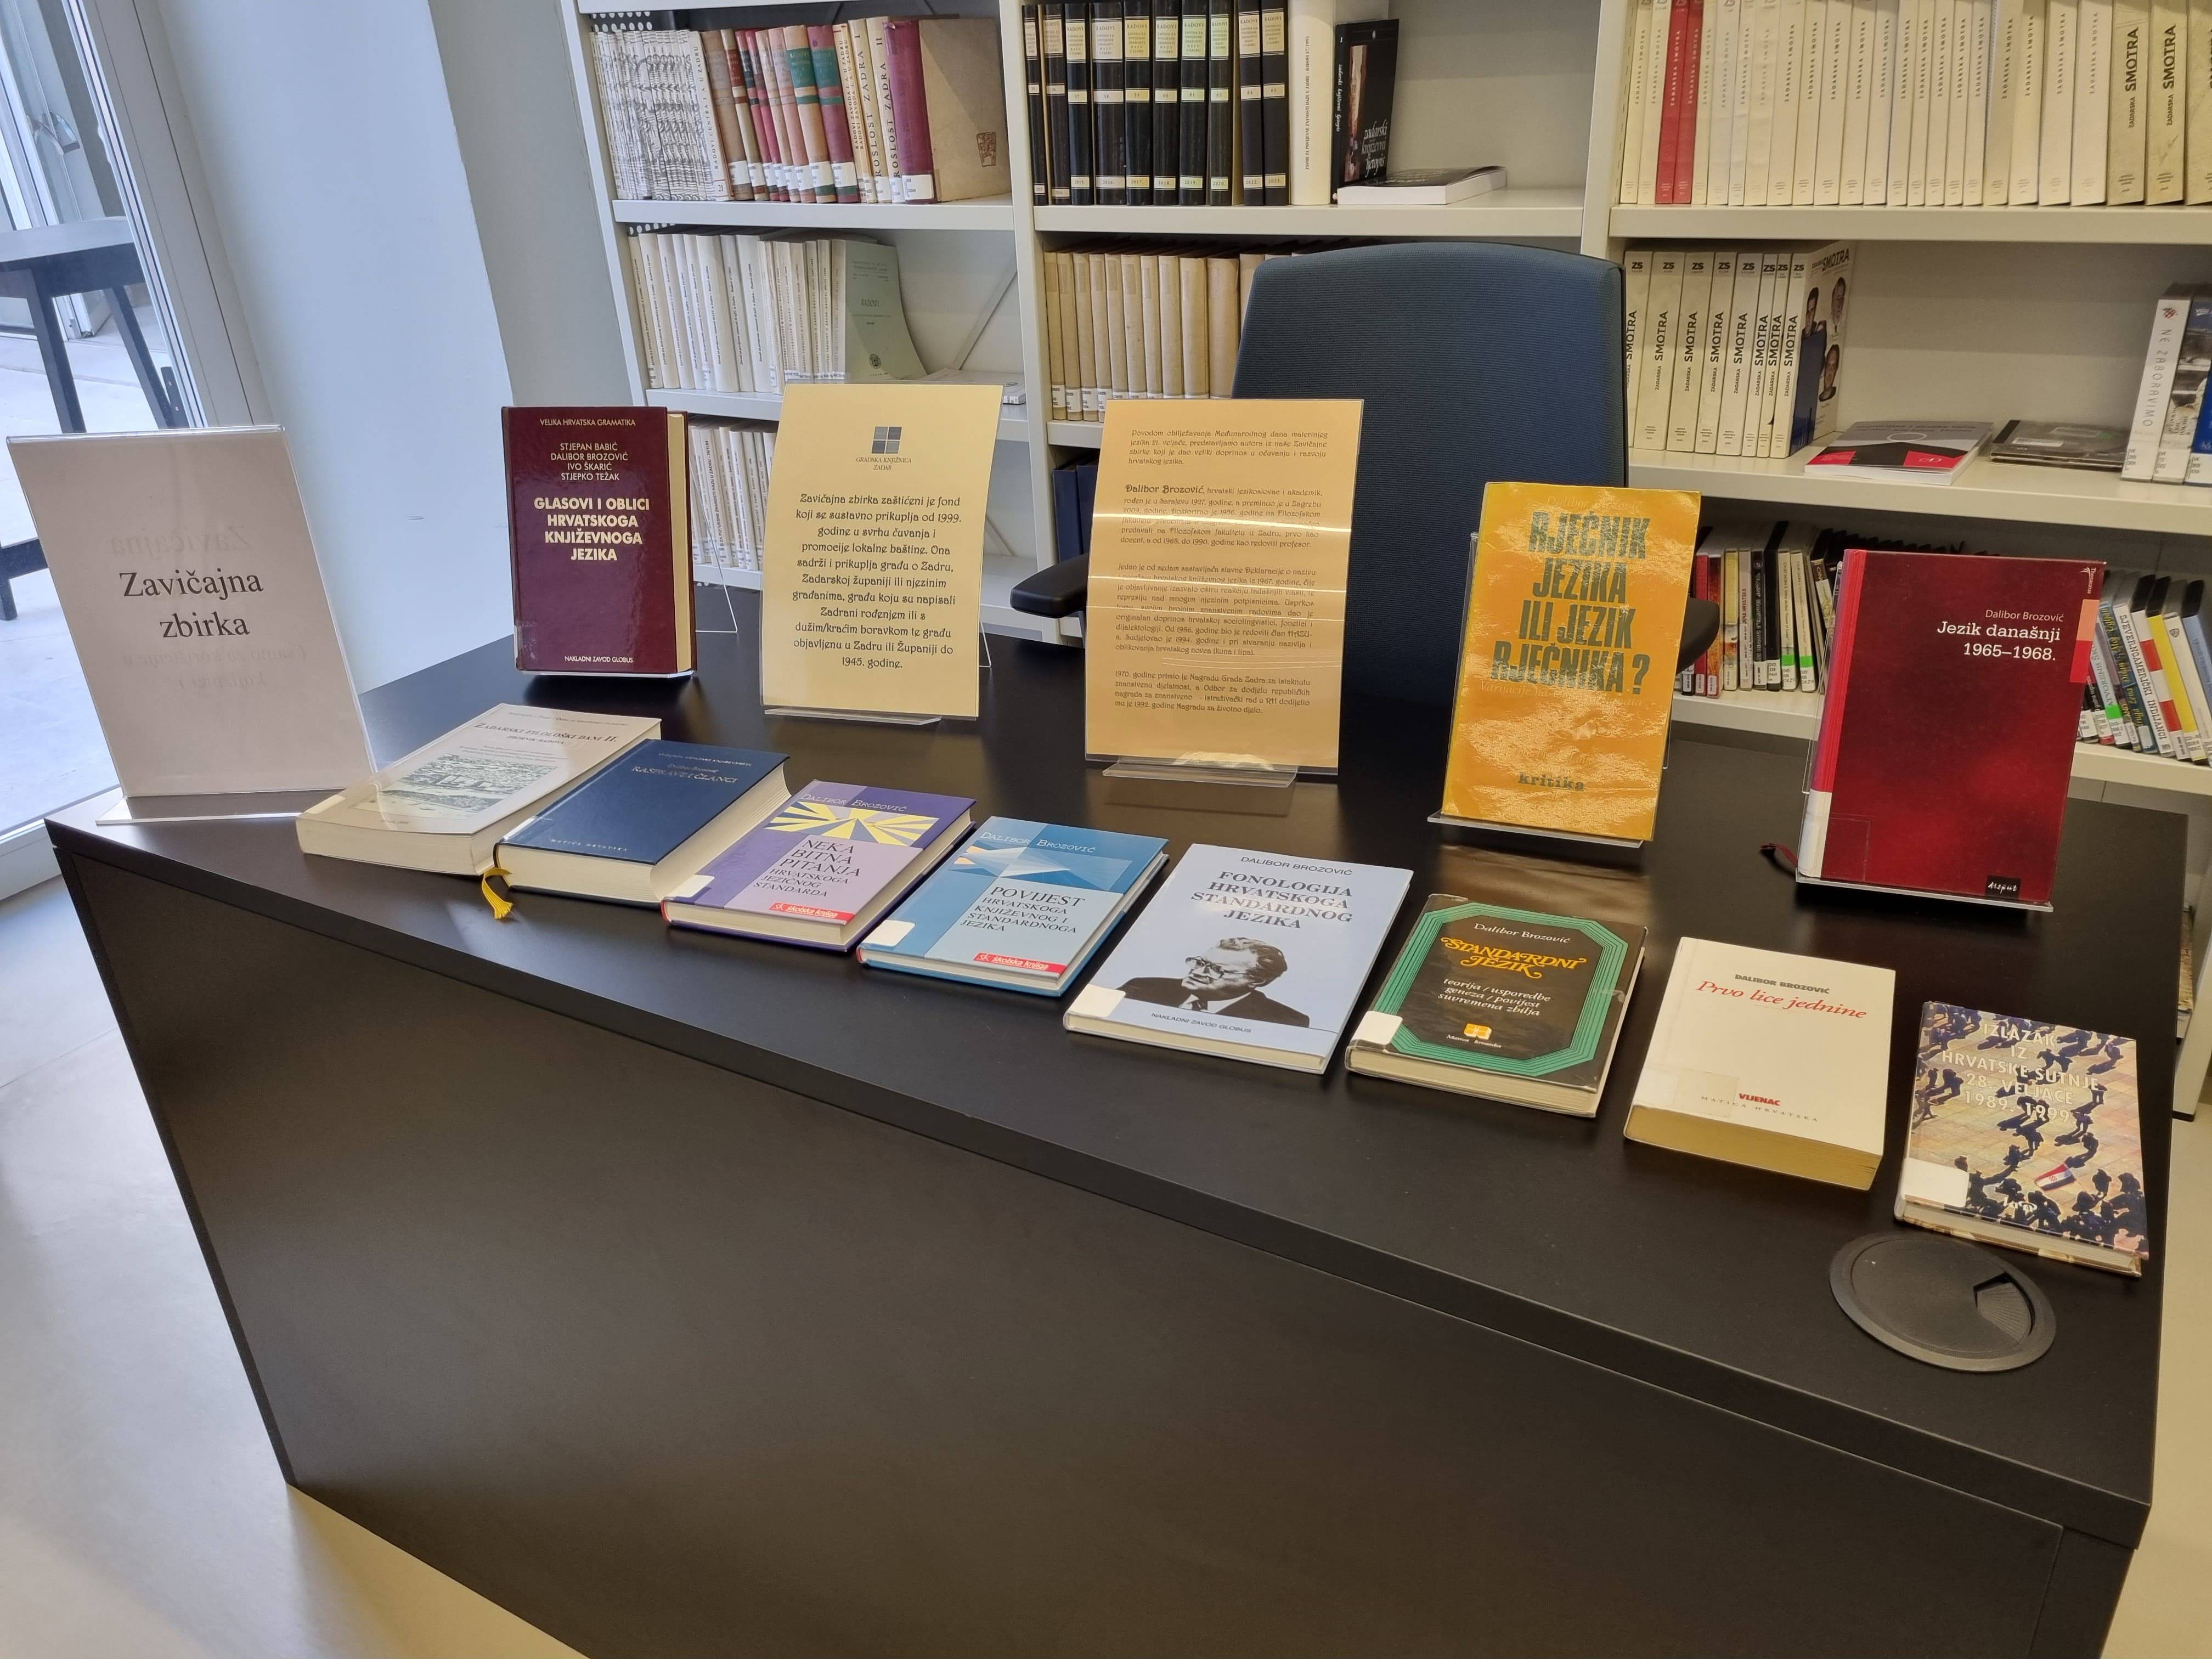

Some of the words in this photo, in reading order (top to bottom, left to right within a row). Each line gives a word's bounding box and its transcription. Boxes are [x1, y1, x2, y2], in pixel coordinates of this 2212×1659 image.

[2125, 27, 2140, 92] SMOTRA
[858, 50, 870, 101] ZADRA
[1364, 119, 1388, 139] zadarski
[1655, 311, 1668, 361] SMOTRA
[1684, 312, 1697, 362] SMOTRA
[2159, 329, 2172, 343] NE
[2142, 350, 2167, 427] ZABORAVIMO
[595, 441, 618, 451] BABIĆ
[584, 461, 612, 471] ŠKARIĆ
[587, 452, 628, 461] BROZOVIĆ
[595, 471, 619, 481] TEŽAK
[1125, 484, 1159, 493] Dalibor
[1162, 485, 1205, 494] Brozović,
[1237, 488, 1279, 496] jezikoslovac
[534, 497, 593, 510] GLASOVI
[597, 498, 602, 510] I
[606, 499, 650, 510] OBLICI
[800, 493, 845, 505] Zavičajna
[849, 494, 878, 504] zbirka
[881, 495, 924, 506] zaštićeni
[926, 496, 935, 507] je
[937, 495, 960, 507] fond
[548, 515, 638, 527] HRVATSKOGA
[796, 510, 813, 521] koji
[830, 511, 873, 521] sustavno
[876, 511, 919, 522] prikuplja
[922, 512, 935, 522] od
[938, 513, 961, 523] 1999.
[545, 528, 642, 544] KNJIŽEVNOGA
[817, 527, 850, 537] godine
[862, 527, 890, 537] svrhu
[892, 527, 930, 539] čuvanja
[933, 528, 936, 538] i
[1529, 511, 1650, 560] RJEČNIK
[571, 549, 617, 561] JEZIKA
[119, 568, 263, 600] Zavičajna
[1533, 558, 1627, 602] JEZIKA
[160, 611, 250, 639] zbirka
[1519, 601, 1549, 640] ILI
[1556, 604, 1635, 649] JEZIK
[1985, 610, 2020, 620] Dalibor
[2022, 612, 2064, 622] Brozović
[1937, 622, 1980, 636] Jezik
[1986, 625, 2061, 641] današnji
[793, 638, 843, 652] objavljenu
[854, 640, 882, 652] Zadru
[885, 642, 894, 652] ili
[897, 640, 938, 656] Županiji
[941, 645, 953, 654] do
[842, 657, 865, 667] 1945.
[868, 657, 903, 669] godine.
[1490, 641, 1624, 693] RJEČNIKA
[1632, 655, 1650, 695] ?
[2120, 615, 2153, 696] SJEVERNOAMERIČKI
[2147, 699, 2168, 740] INDIJANCI
[474, 723, 524, 733] ZADARSKI
[694, 772, 738, 783] ČLANCI
[1517, 772, 1584, 792] kritika
[802, 793, 847, 805] DALIBOR
[851, 799, 907, 811] BROZOVIĆ
[802, 839, 854, 853] NEKA
[980, 832, 1030, 844] DALIBOR
[1036, 839, 1096, 853] BROZOVIĆ
[791, 849, 852, 864] BITNA
[1240, 856, 1290, 868] DALIBOR
[1293, 862, 1352, 876] BROZOVIĆ
[769, 868, 849, 884] HRVATSKOGA
[778, 859, 861, 877] PITANJA
[753, 882, 828, 896] STANDARDA
[761, 876, 822, 888] JEZIČNOG
[1218, 871, 1352, 897] FONOLOGIJA
[990, 887, 1085, 906] POVIJEST
[1207, 882, 1349, 909] HRVATSKOGA
[786, 904, 815, 916] školska
[814, 909, 839, 918] knjiga
[974, 905, 1060, 923] KNJIŽEVNOG
[981, 898, 1068, 914] HRVATSKOGA
[1191, 891, 1353, 923] STANDARDNOG
[960, 920, 1005, 931] JEZIKA
[967, 913, 1077, 933] STANDARDNOGA
[1223, 910, 1302, 929] JEZIKA
[1474, 923, 1519, 937] Dalibor
[1521, 931, 1571, 944] Brozović
[991, 956, 1023, 967] školska
[1024, 960, 1048, 970] knjiga
[1441, 938, 1587, 969] STANDARDNI
[1460, 956, 1543, 979] JEZIK
[1443, 978, 1481, 991] teorija
[1491, 987, 1551, 1002] usporedbe
[1735, 974, 1776, 986] DALIBOR
[1779, 981, 1830, 994] BROZOVIĆ
[1437, 994, 1503, 1011] suvremena
[1506, 1005, 1541, 1017] zbilja
[1444, 987, 1485, 999] geneza
[1495, 995, 1541, 1009] povijest
[1695, 981, 1744, 998] Prvo
[1750, 990, 1784, 1004] lice
[1783, 997, 1867, 1019] jednine
[1150, 1012, 1189, 1024] NAKLADNI
[1190, 1019, 1218, 1028] ZAVOD
[1220, 1024, 1252, 1033] GLOBUS
[1984, 1023, 2056, 1047] IZLAZAK
[2011, 1046, 2027, 1059] IZ
[1942, 1050, 2028, 1079] HRVATSKE
[2035, 1063, 2099, 1091] ŠUTNJE
[1966, 1073, 1993, 1088] 28.
[2001, 1080, 2073, 1105] VELJAČE
[1701, 1096, 1746, 1108] MATICA
[1755, 1105, 1819, 1122] HRVATSKA
[1738, 1093, 1780, 1106] VIJENAC
